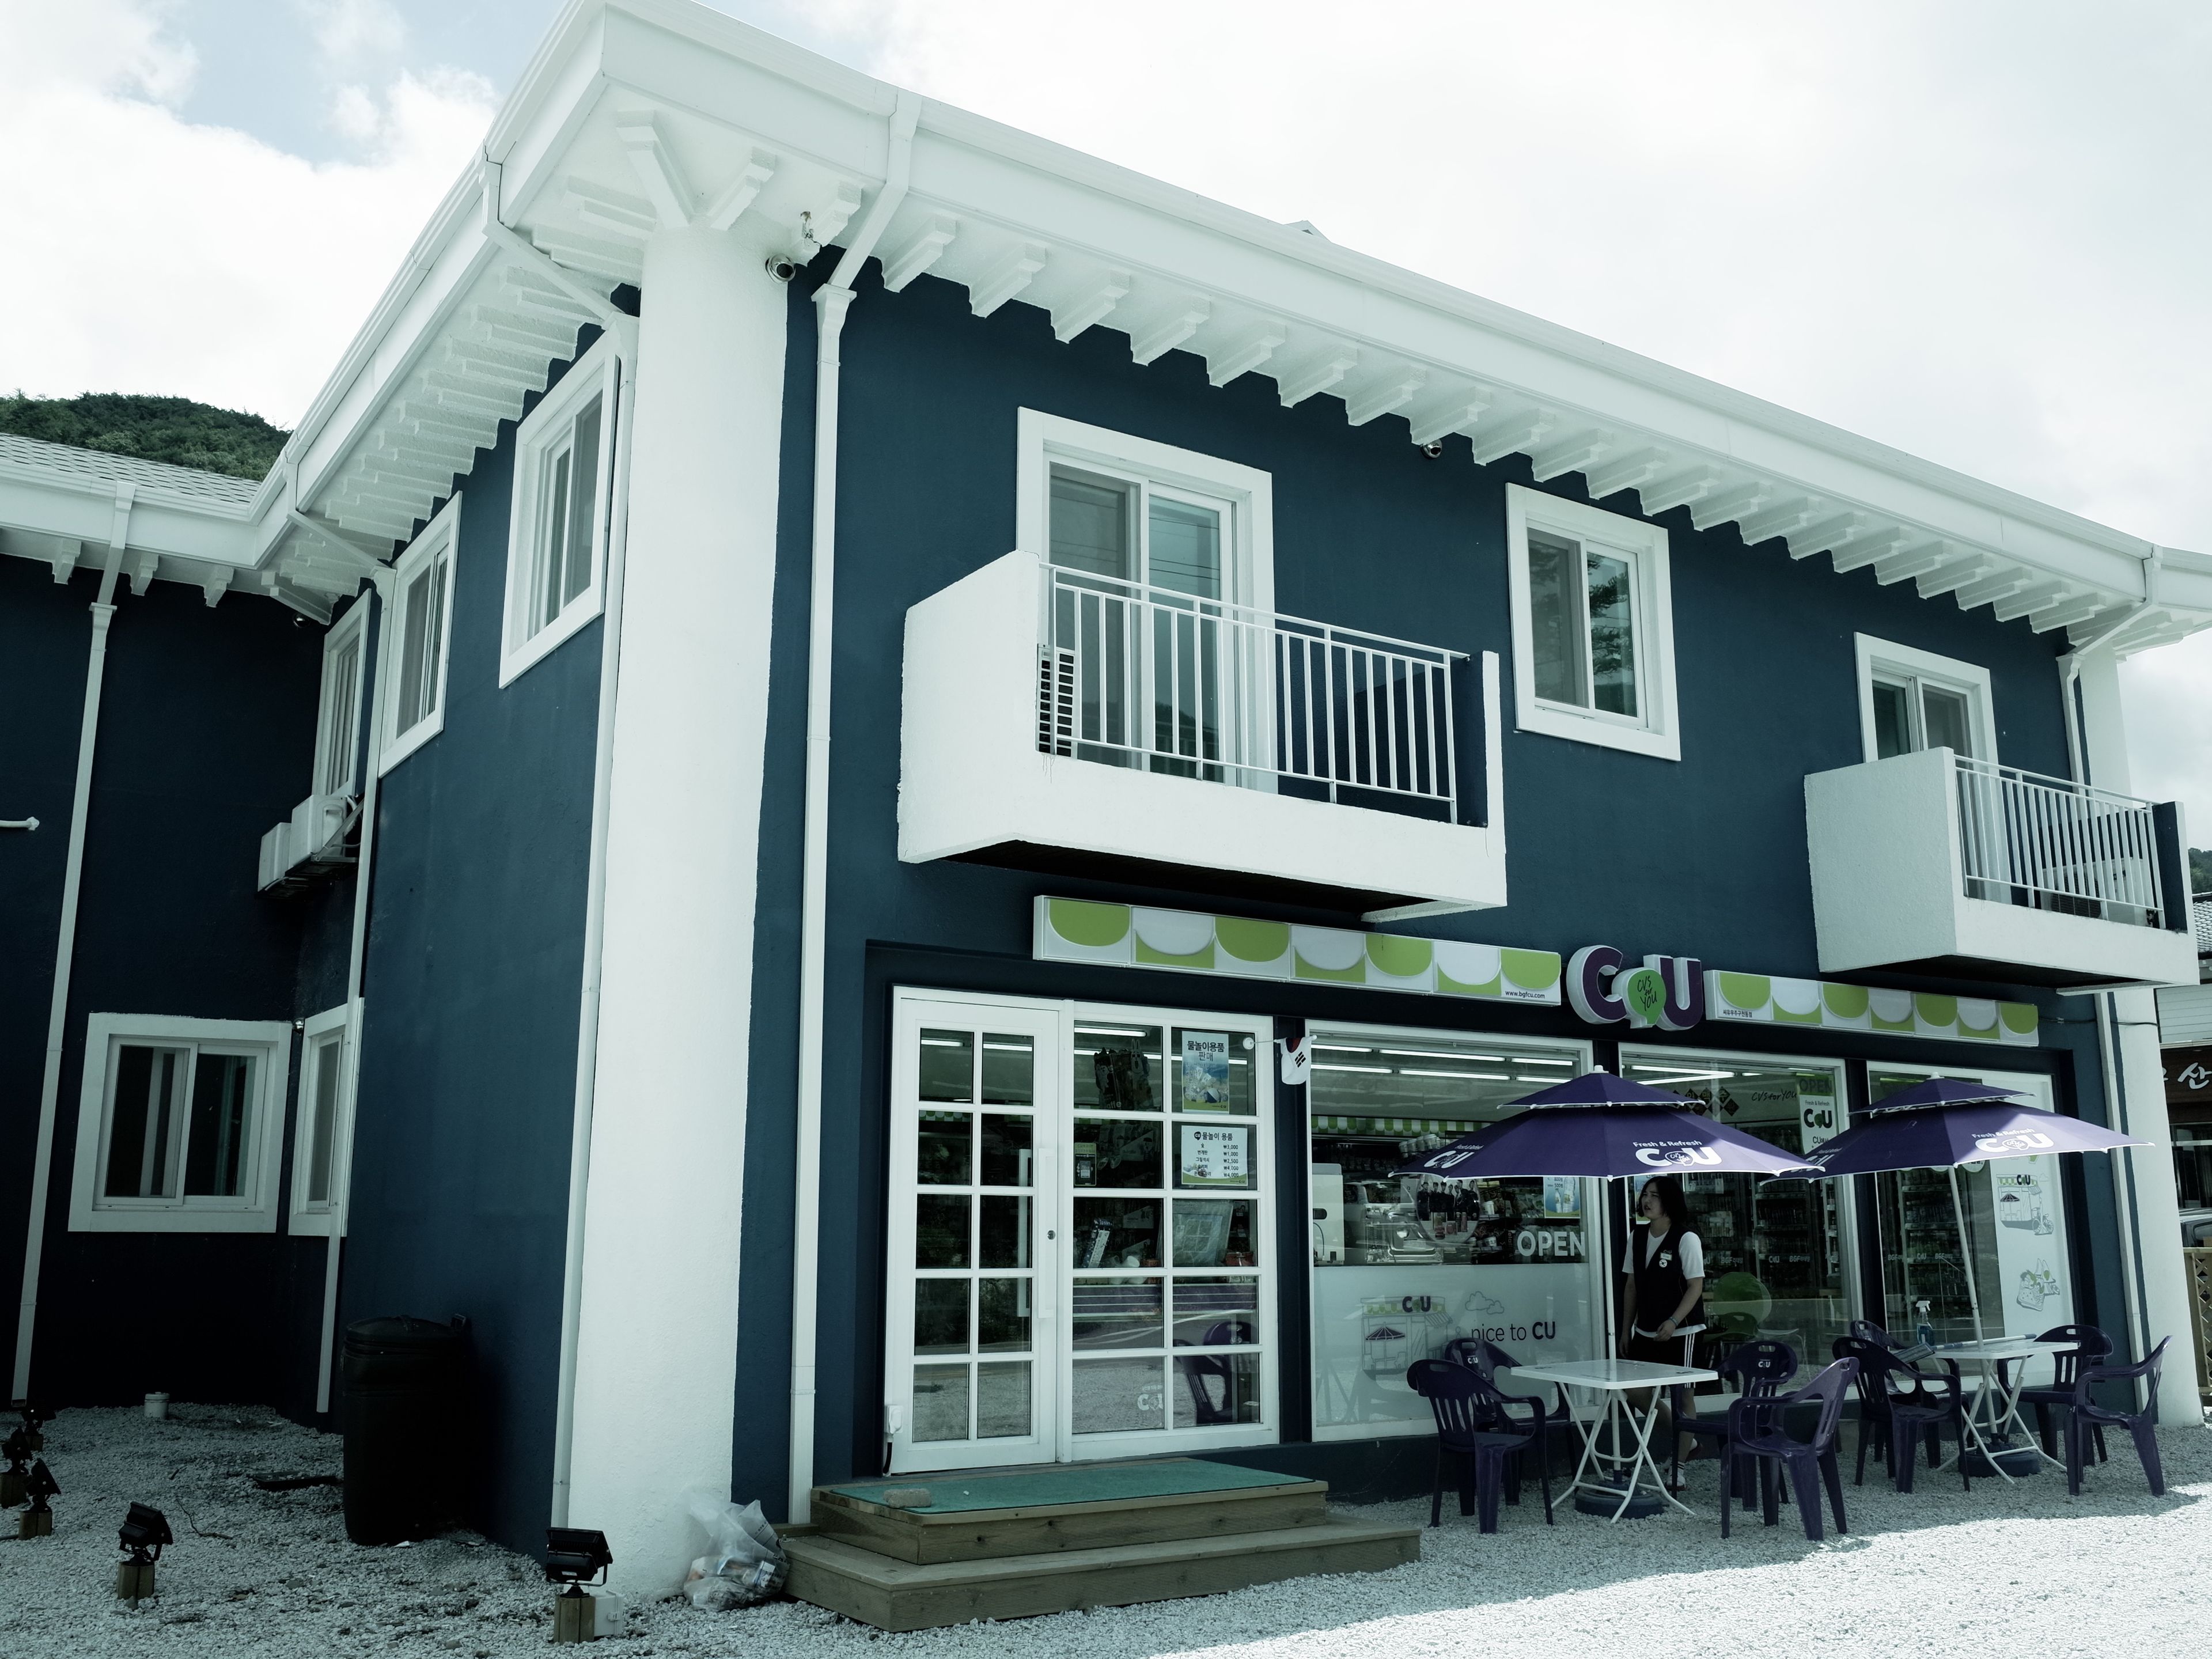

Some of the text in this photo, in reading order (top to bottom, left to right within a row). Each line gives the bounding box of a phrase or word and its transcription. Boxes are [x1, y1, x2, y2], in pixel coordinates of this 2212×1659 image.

[1566, 945, 1703, 1032] CU
[1637, 975, 1652, 992] CVS
[1645, 987, 1653, 997] for
[1505, 990, 1545, 999] www.bgfcu.com
[1639, 991, 1657, 1012] YOU
[1187, 1040, 1225, 1052] 물놀이용품
[1198, 1051, 1213, 1062] 판매
[1800, 1079, 1832, 1093] OPEN
[1804, 1108, 1833, 1129] CU
[1202, 1132, 1219, 1141] 물놀이
[1221, 1133, 1233, 1141] 용품
[1975, 1133, 2054, 1153] CU
[1635, 1146, 1722, 1166] CU
[2017, 1174, 2031, 1185] CU
[1517, 1230, 1586, 1257] OPEN
[1402, 1296, 1431, 1313] CU
[1471, 1321, 1556, 1342] nice to CU
